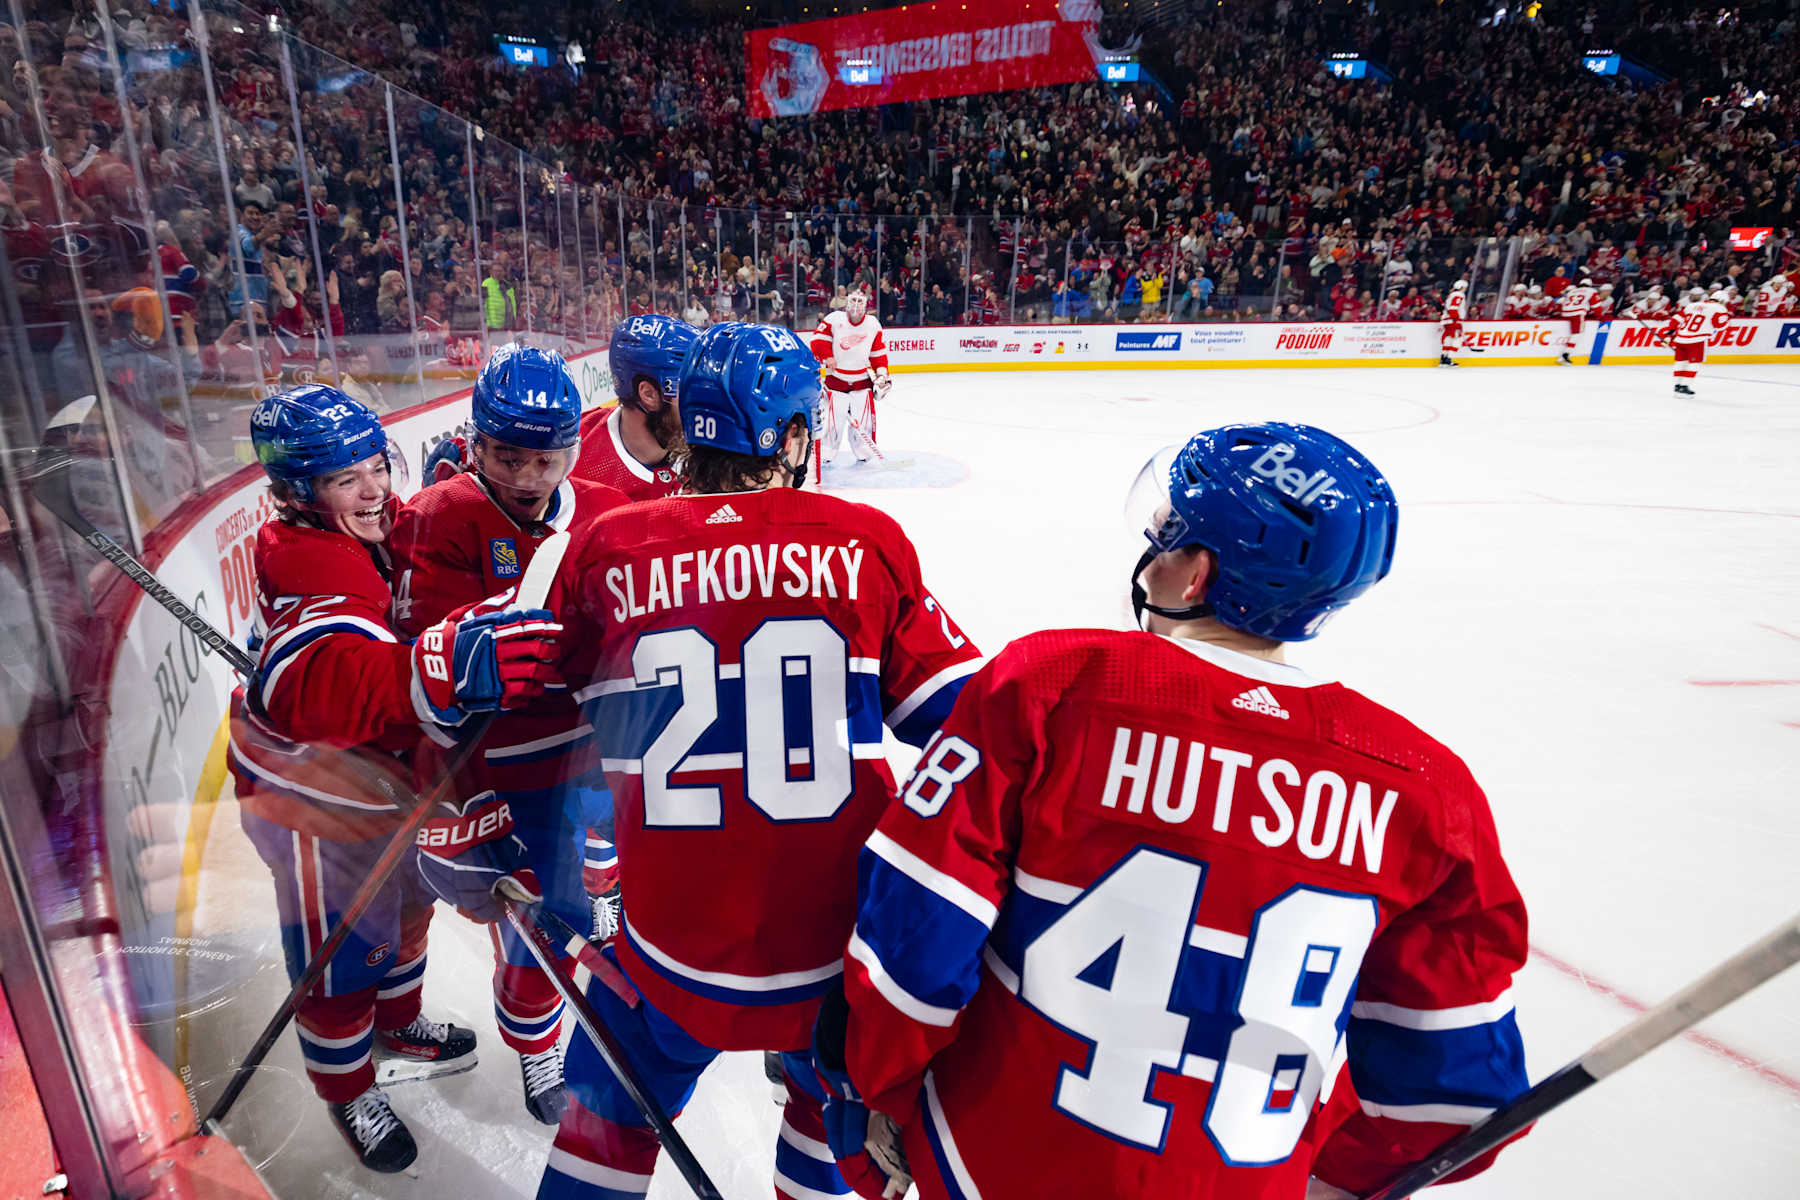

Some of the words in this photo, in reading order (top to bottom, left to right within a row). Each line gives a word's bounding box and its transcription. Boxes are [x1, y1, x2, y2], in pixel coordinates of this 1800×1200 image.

[850, 69, 868, 83] Bell
[1107, 66, 1126, 79] Bell
[630, 318, 663, 338] Bell
[761, 329, 800, 352] Bell
[889, 339, 935, 352] ENSEMBLE
[1151, 335, 1178, 348] MF
[1276, 334, 1333, 349] PODIUM
[521, 389, 547, 408] 14
[252, 404, 283, 427] Bell
[319, 403, 354, 422] 22
[694, 415, 716, 440] 20
[1250, 442, 1337, 507] Bell
[705, 514, 743, 525] adidas
[497, 564, 519, 575] RBC
[605, 539, 864, 623] SLAFKOVSKÝ
[85, 530, 229, 653] SHERWOOD
[922, 594, 966, 651] 2
[1231, 696, 1290, 720] adidas
[631, 615, 857, 831] 20
[1100, 726, 1400, 875] HUTSON
[415, 802, 514, 848] BAUER
[1017, 842, 1380, 1169] 48
